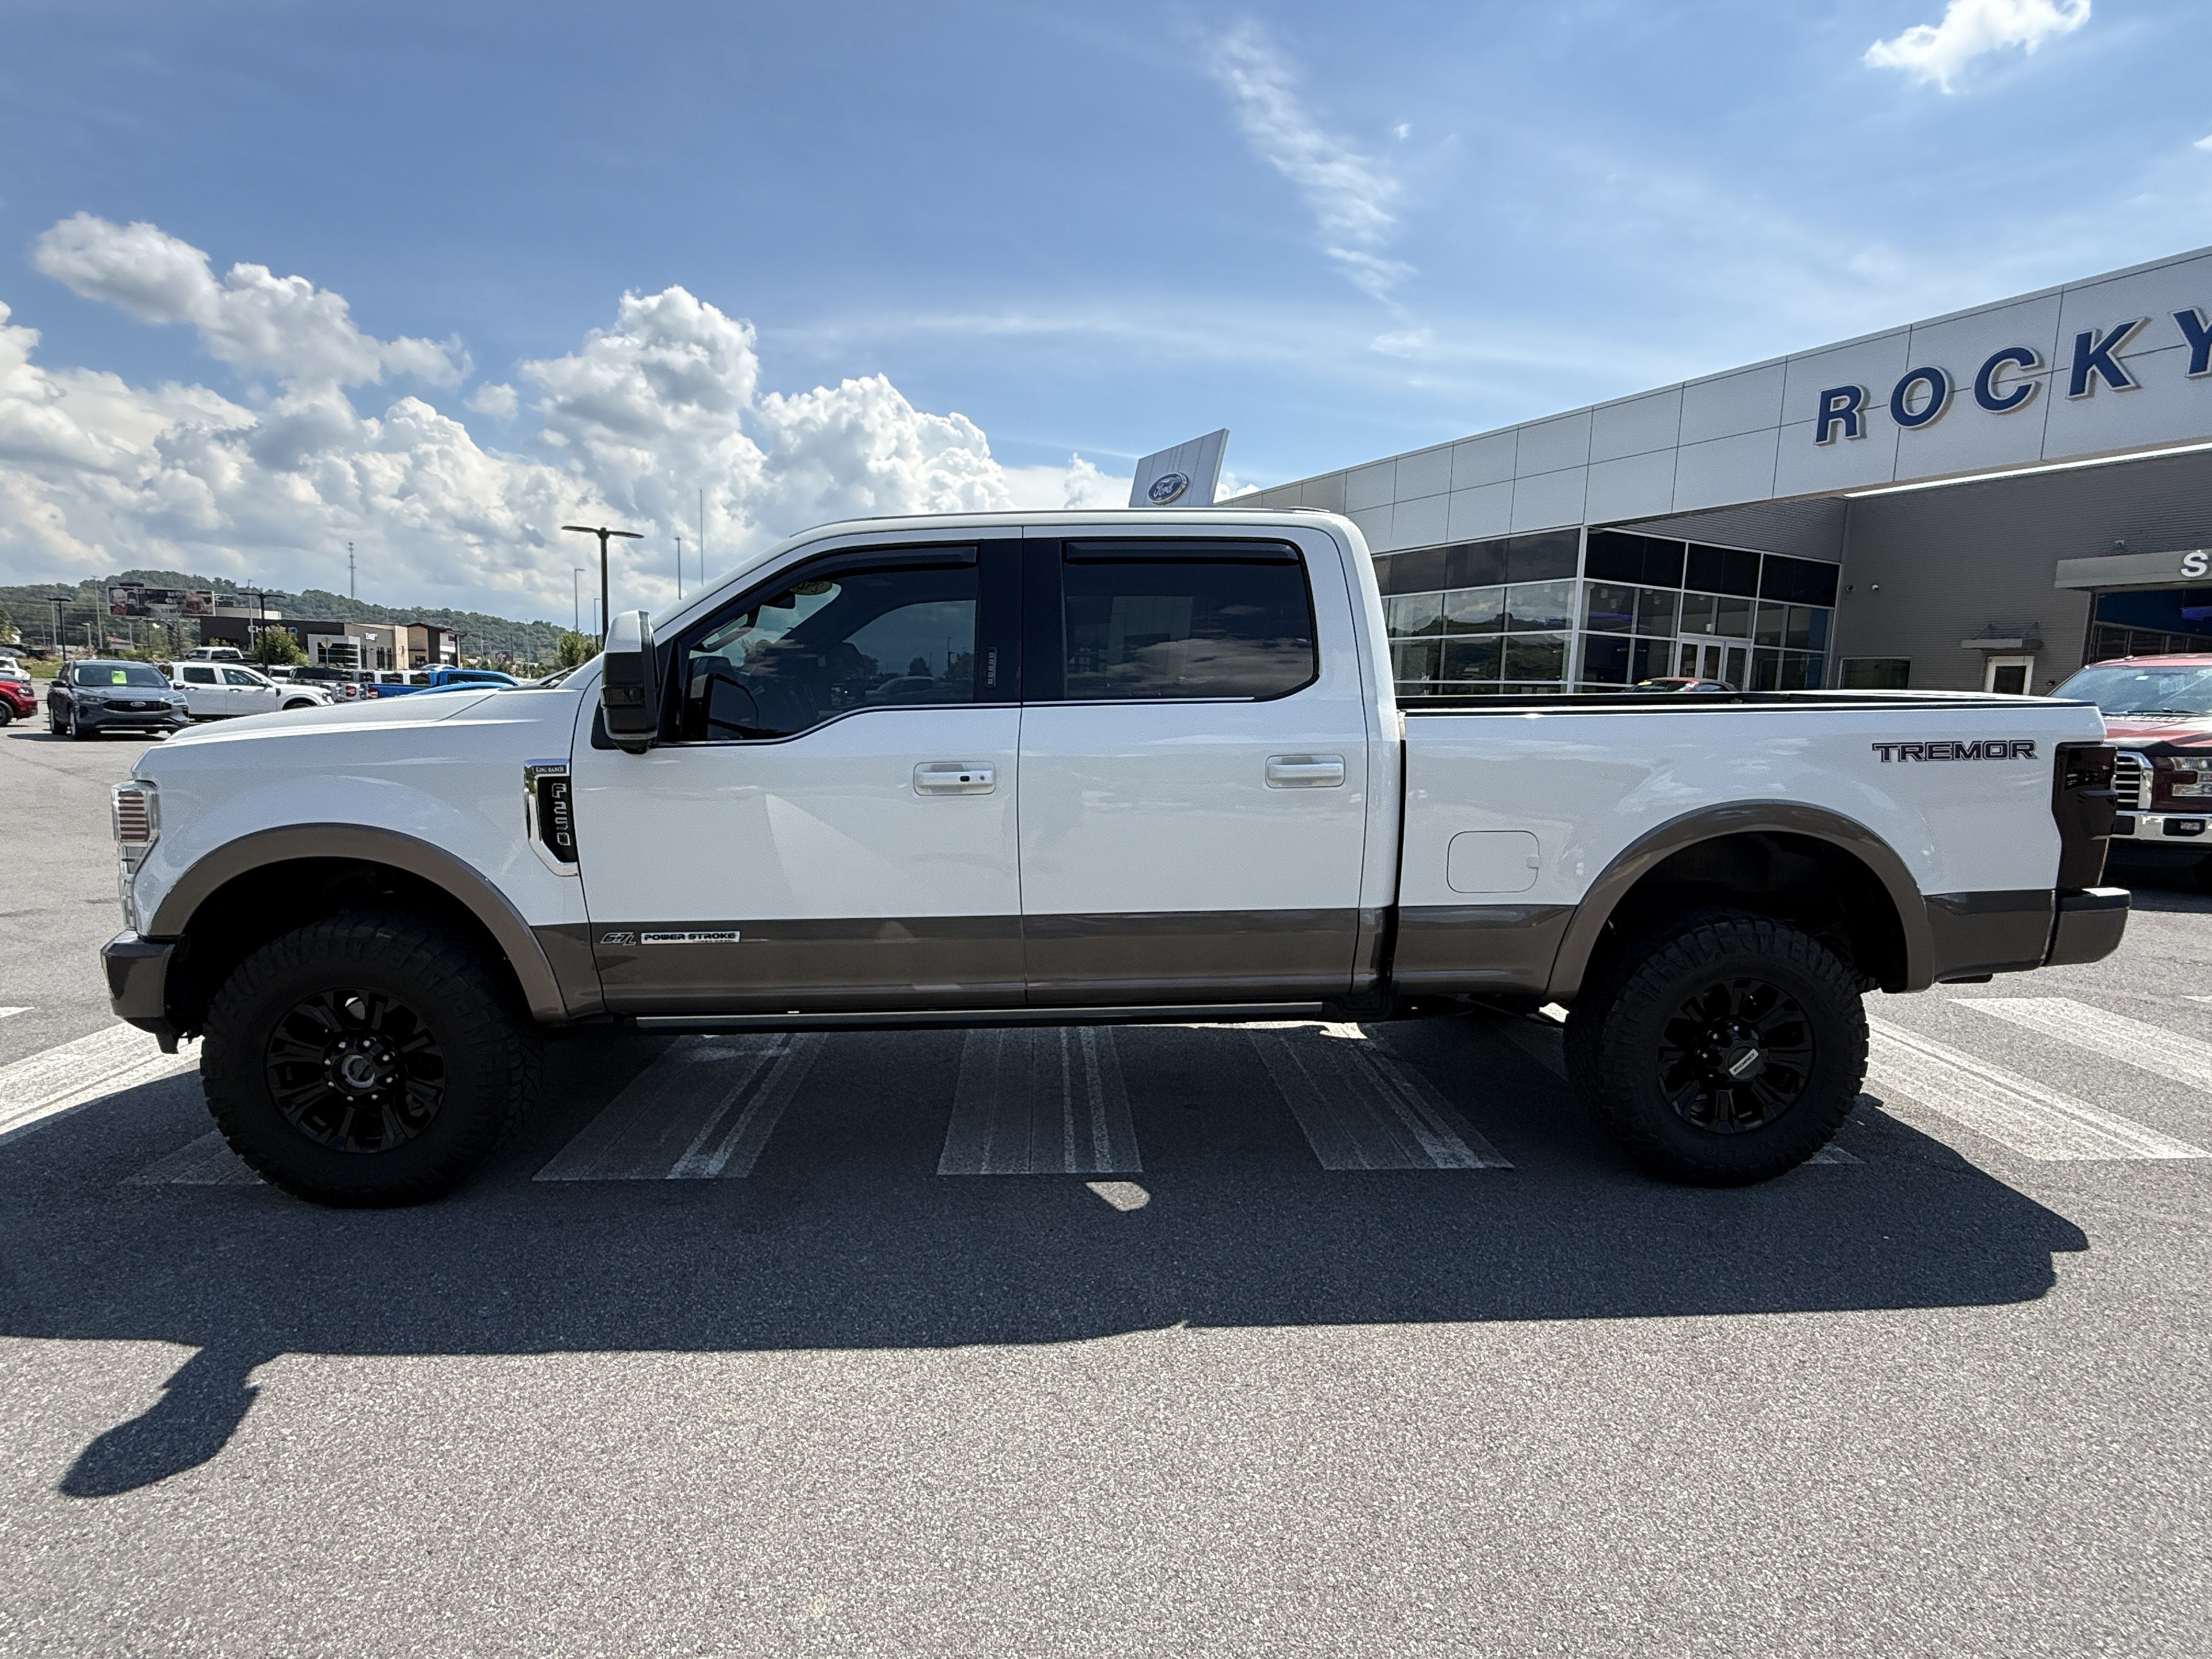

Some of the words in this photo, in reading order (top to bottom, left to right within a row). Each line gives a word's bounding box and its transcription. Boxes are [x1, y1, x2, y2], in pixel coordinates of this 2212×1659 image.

[1813, 307, 2212, 445] ROCKY
[248, 625, 287, 634] CHAE
[1872, 740, 2037, 763] TREMOR
